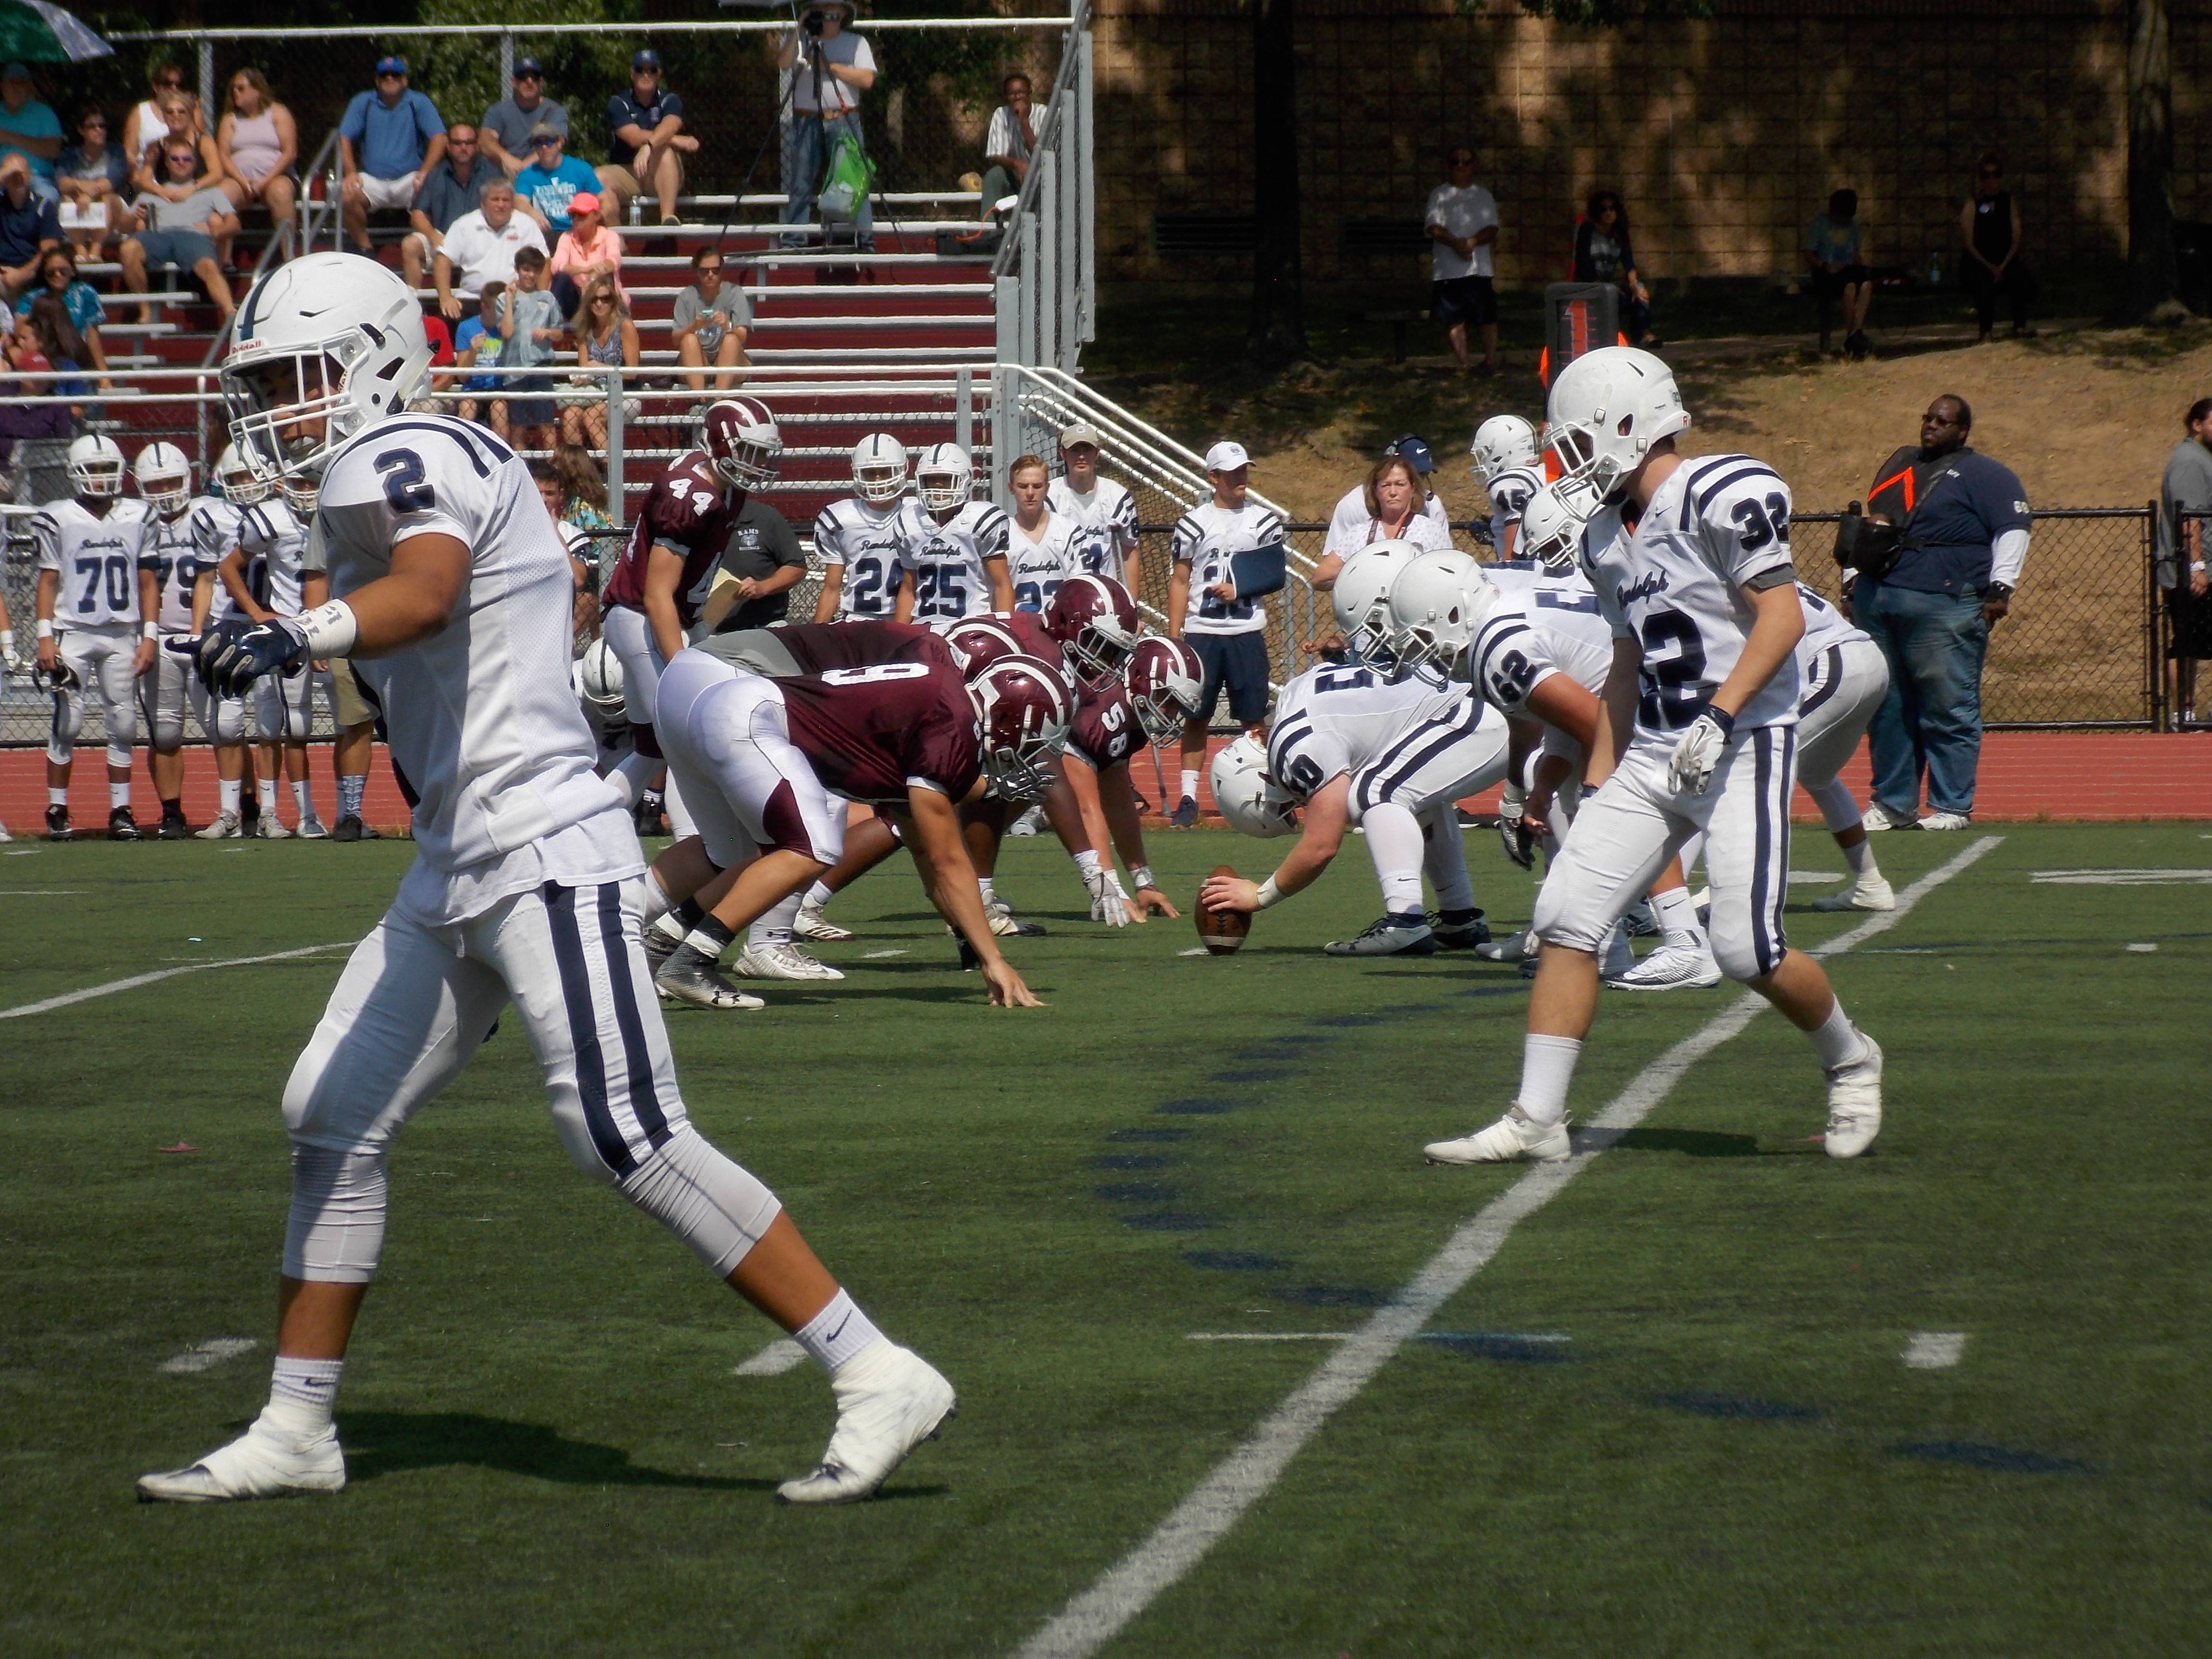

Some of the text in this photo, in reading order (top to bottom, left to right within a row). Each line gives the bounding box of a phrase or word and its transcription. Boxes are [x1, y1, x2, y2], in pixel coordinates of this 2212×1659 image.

[1564, 299, 1587, 361] 1
[373, 447, 435, 514] 2
[669, 478, 714, 517] 44
[1496, 489, 1527, 514] 45
[1730, 492, 1789, 552] 32
[75, 555, 129, 613] 70
[917, 563, 967, 617] 25
[1018, 560, 1061, 575] Randolph
[1491, 649, 1538, 704] 62
